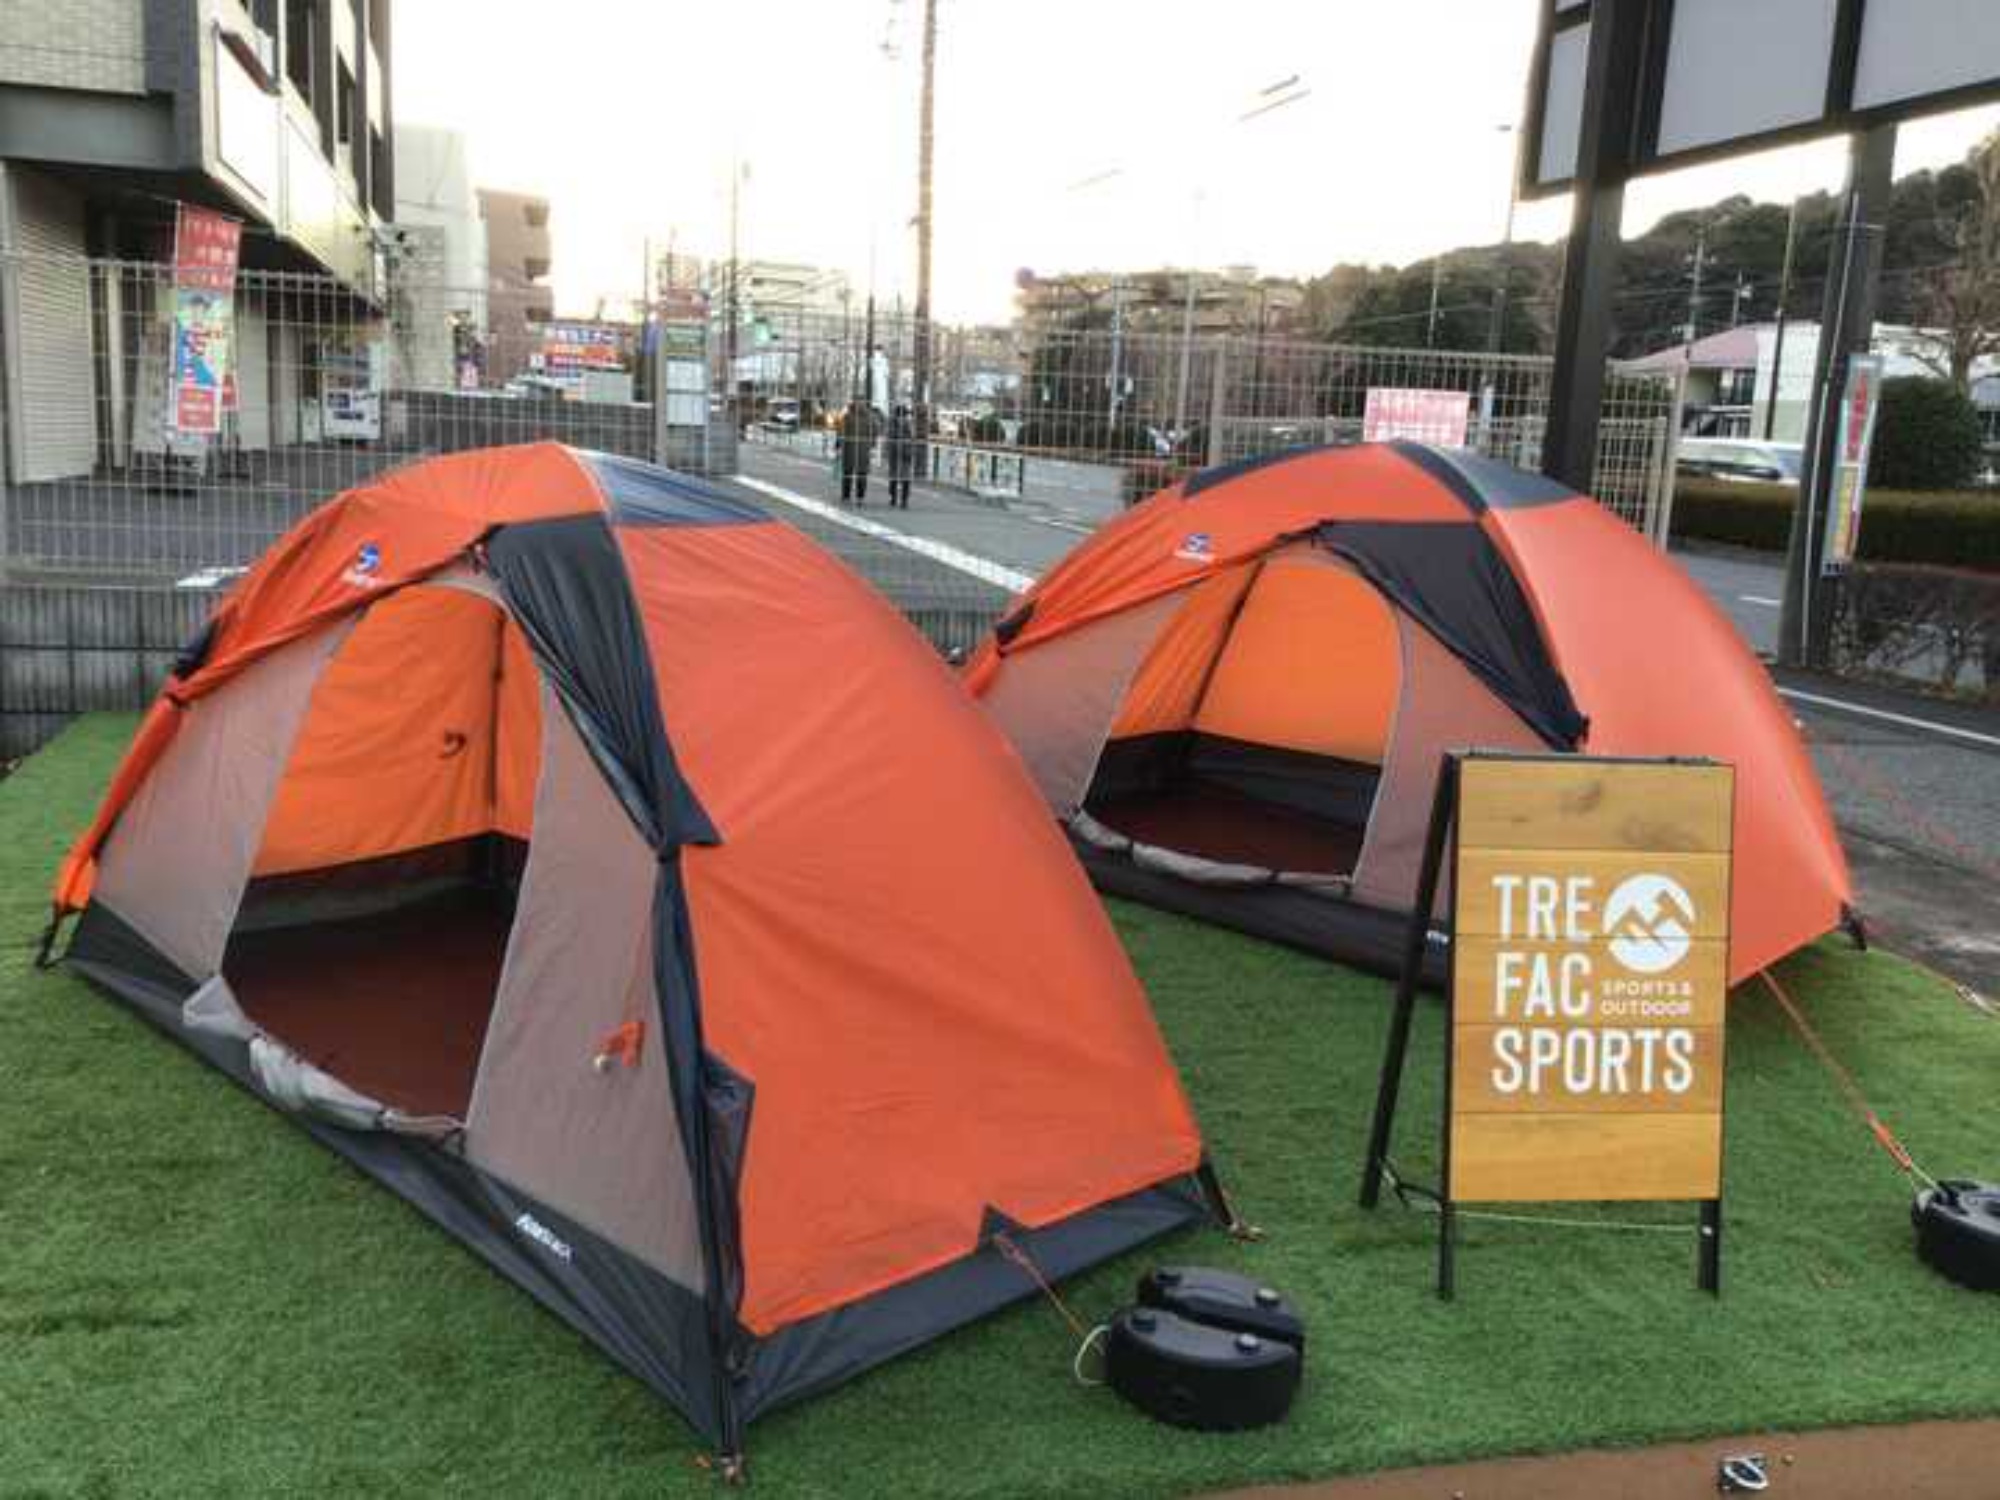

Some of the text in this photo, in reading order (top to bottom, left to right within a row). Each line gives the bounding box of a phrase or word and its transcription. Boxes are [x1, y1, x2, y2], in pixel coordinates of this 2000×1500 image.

[1492, 875, 1594, 942] TRE
[1496, 952, 1591, 1018] FAC
[1601, 981, 1676, 995] SPORTS
[1601, 999, 1691, 1015] OUTDOOR
[1491, 1028, 1694, 1094] SPORTS
